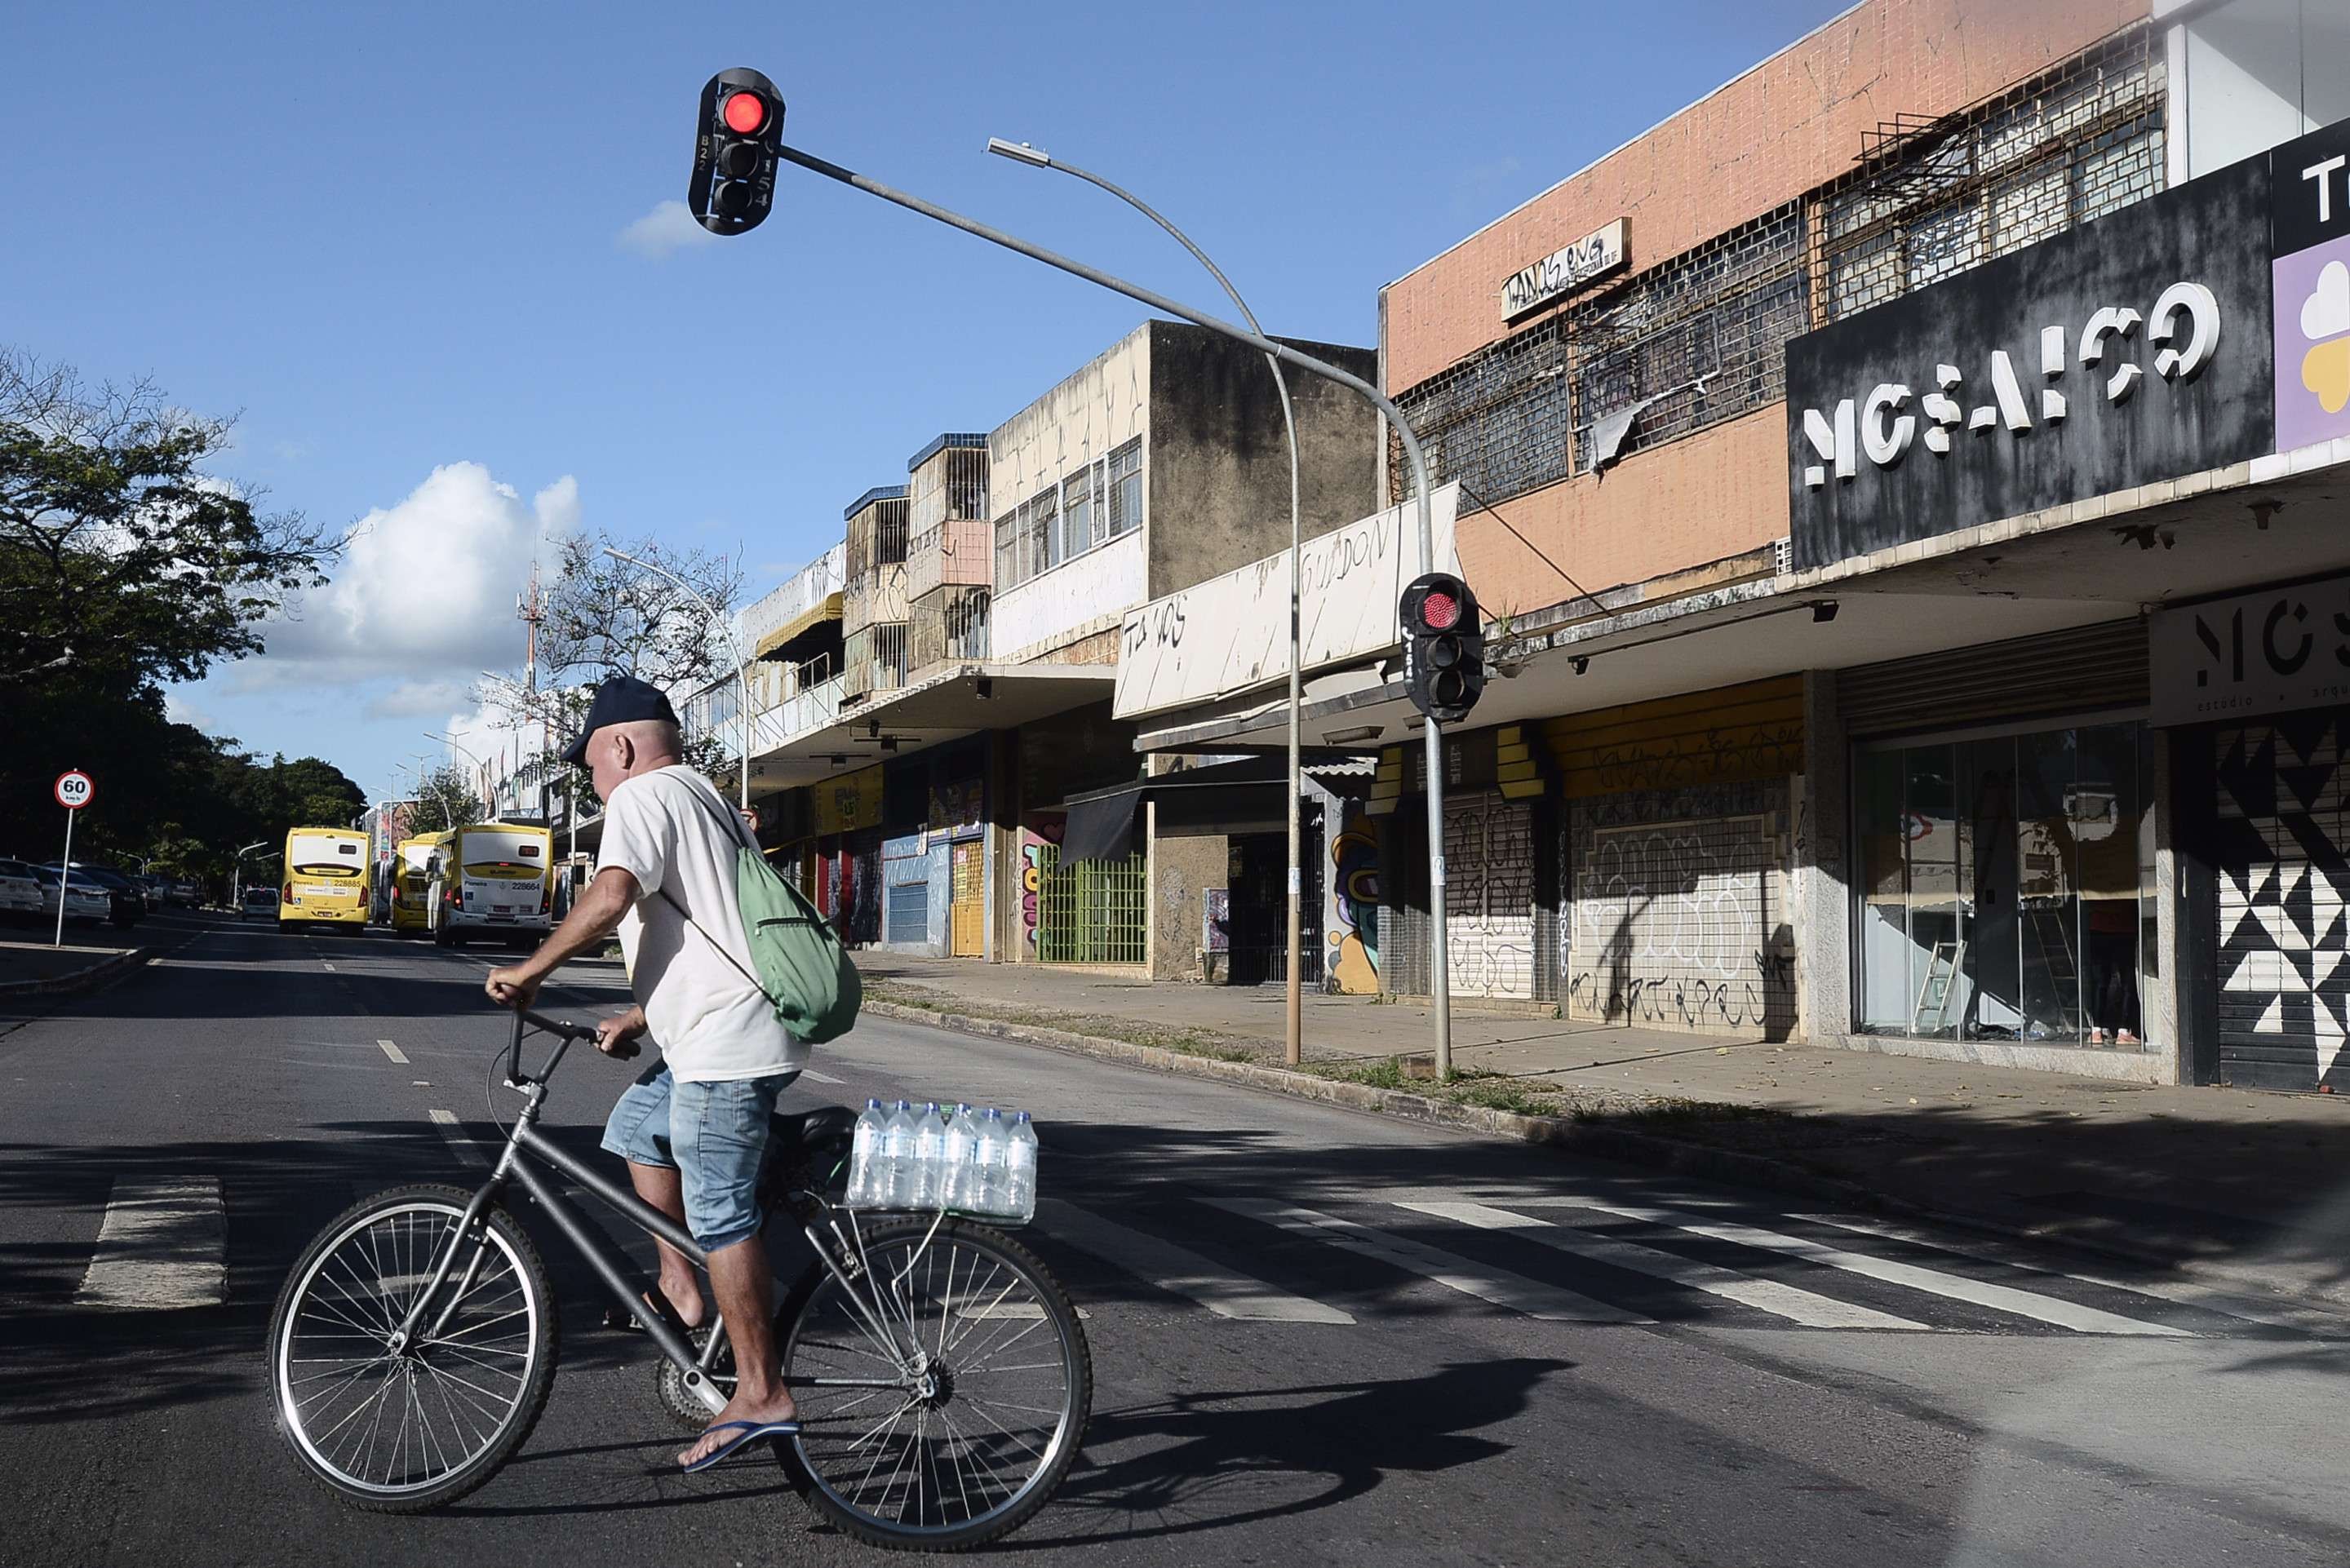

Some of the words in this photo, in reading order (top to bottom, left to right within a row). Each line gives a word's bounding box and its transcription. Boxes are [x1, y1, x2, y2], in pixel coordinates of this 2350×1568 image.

[2302, 154, 2350, 223] T
[1404, 640, 1413, 679] 154
[64, 779, 86, 794] 60
